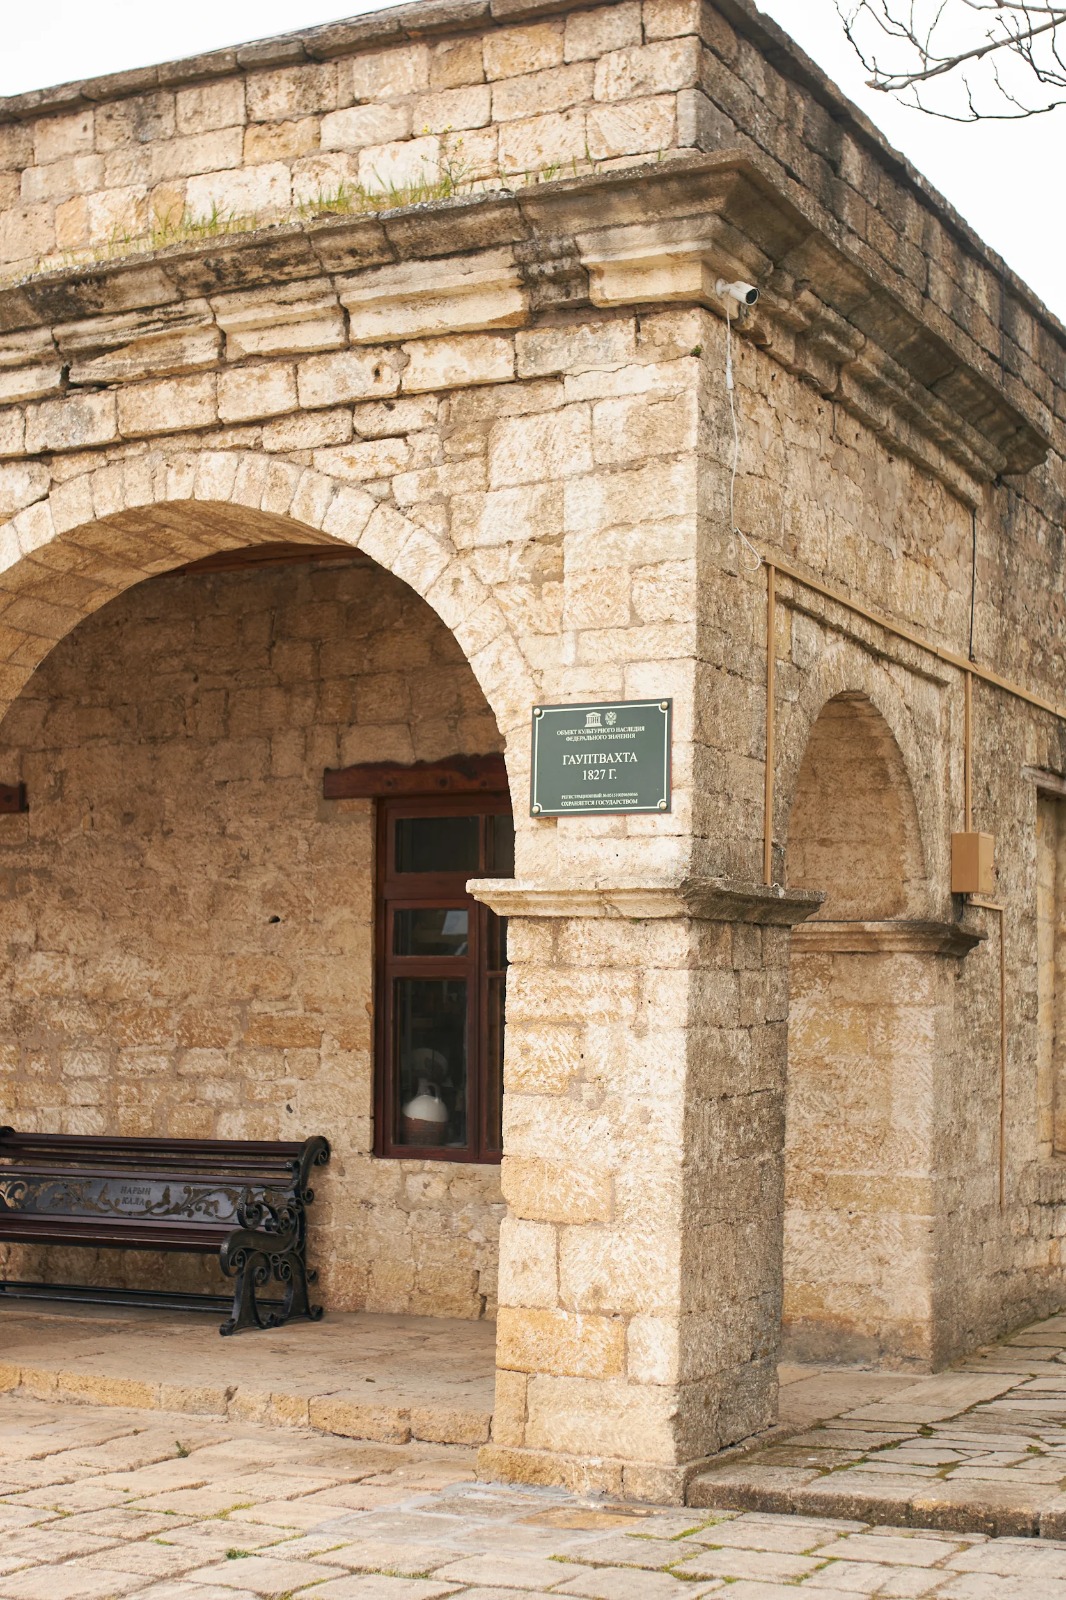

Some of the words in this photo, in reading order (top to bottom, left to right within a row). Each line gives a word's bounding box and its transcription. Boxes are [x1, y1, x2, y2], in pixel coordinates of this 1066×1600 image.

[562, 752, 638, 766] ГАУПТВАХТА
[582, 770, 606, 780] 1827
[608, 769, 617, 780] Г.
[120, 1186, 151, 1195] НАРЫН
[122, 1196, 144, 1206] КАЛА
